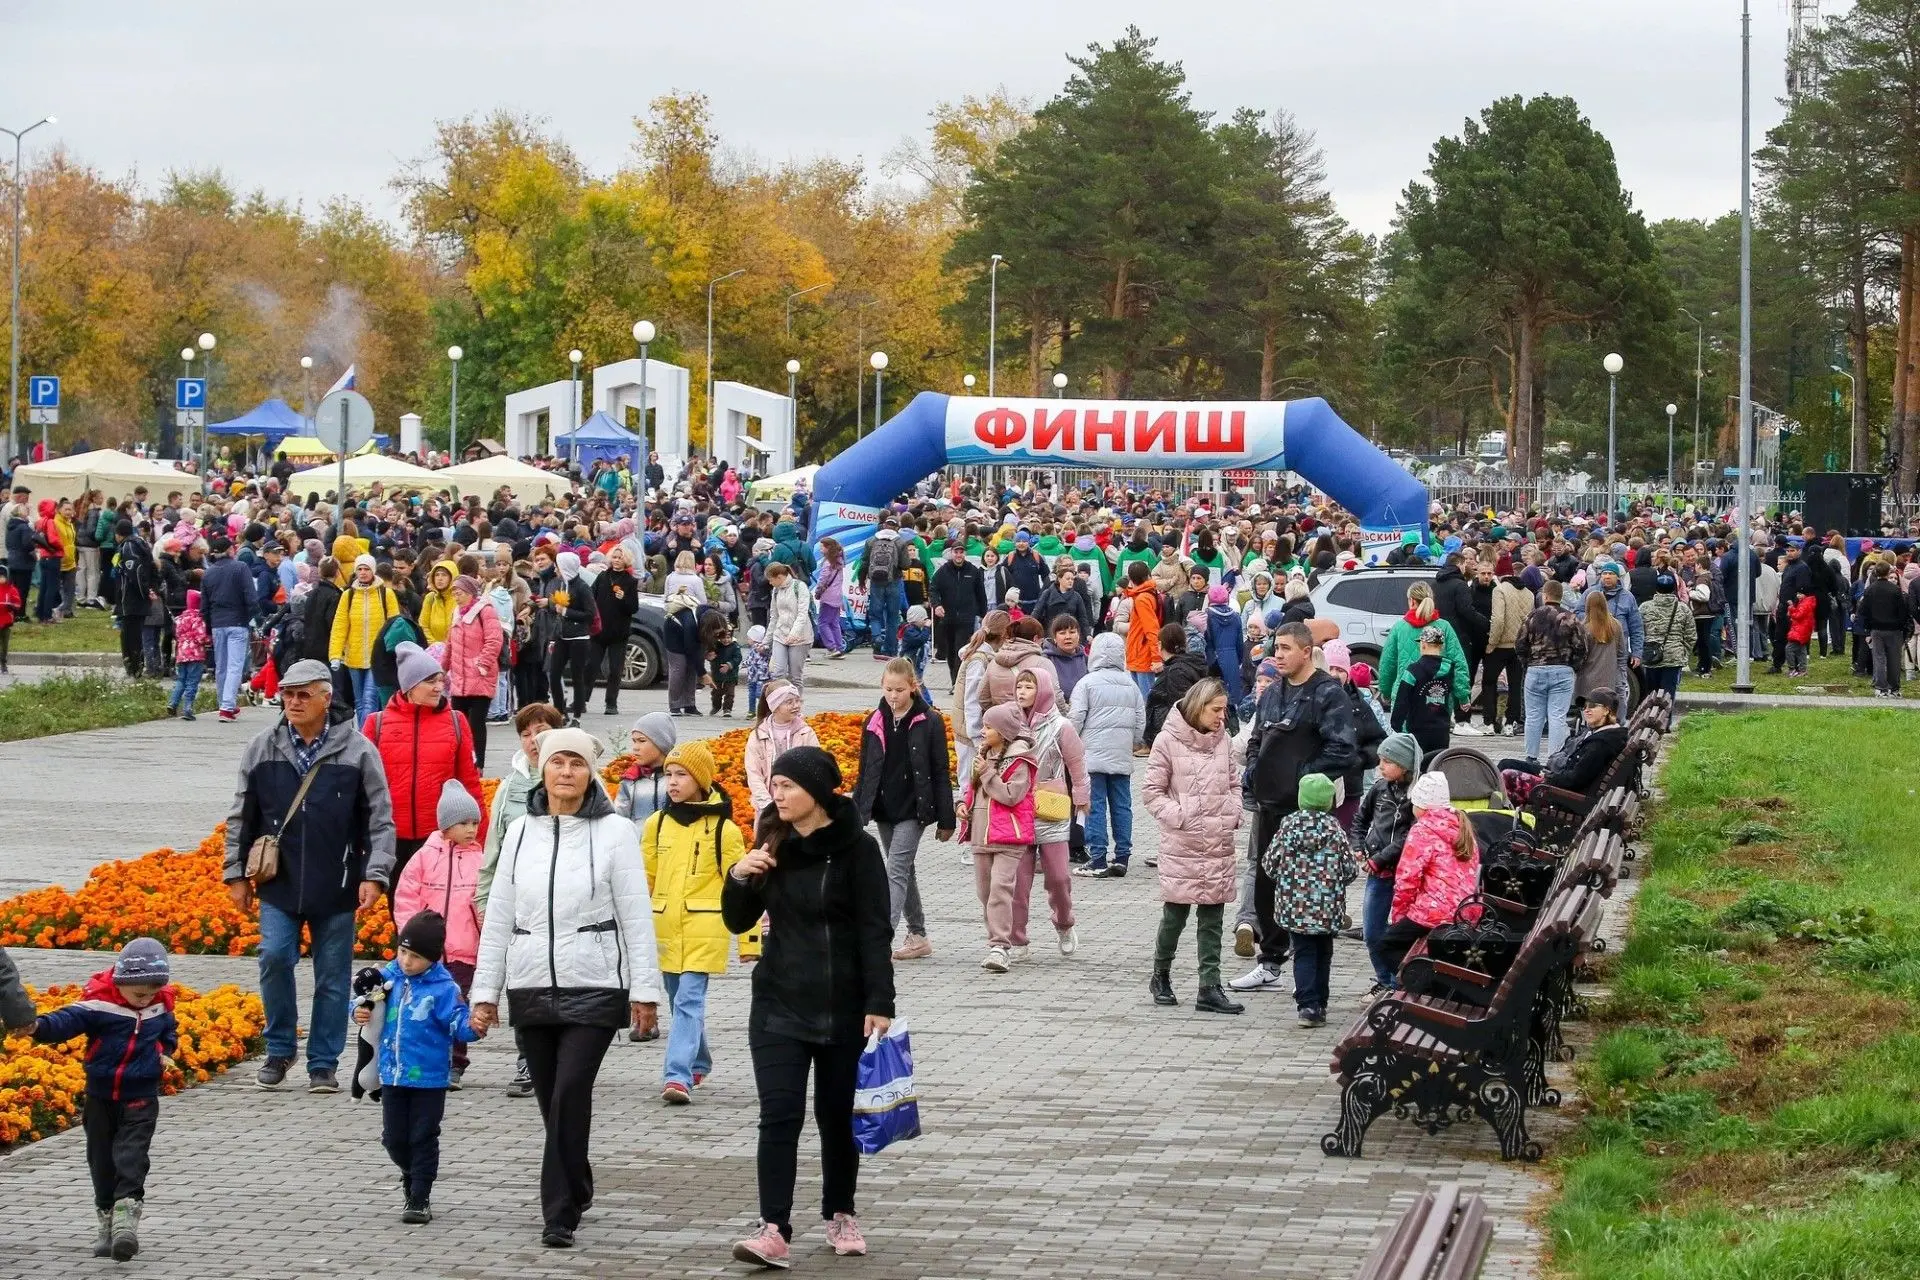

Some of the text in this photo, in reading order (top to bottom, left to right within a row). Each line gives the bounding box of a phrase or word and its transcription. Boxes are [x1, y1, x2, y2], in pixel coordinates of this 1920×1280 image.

[37, 380, 54, 403] P
[184, 382, 201, 405] P
[974, 408, 1246, 452] ФИНИШ
[838, 507, 880, 522] Камен
